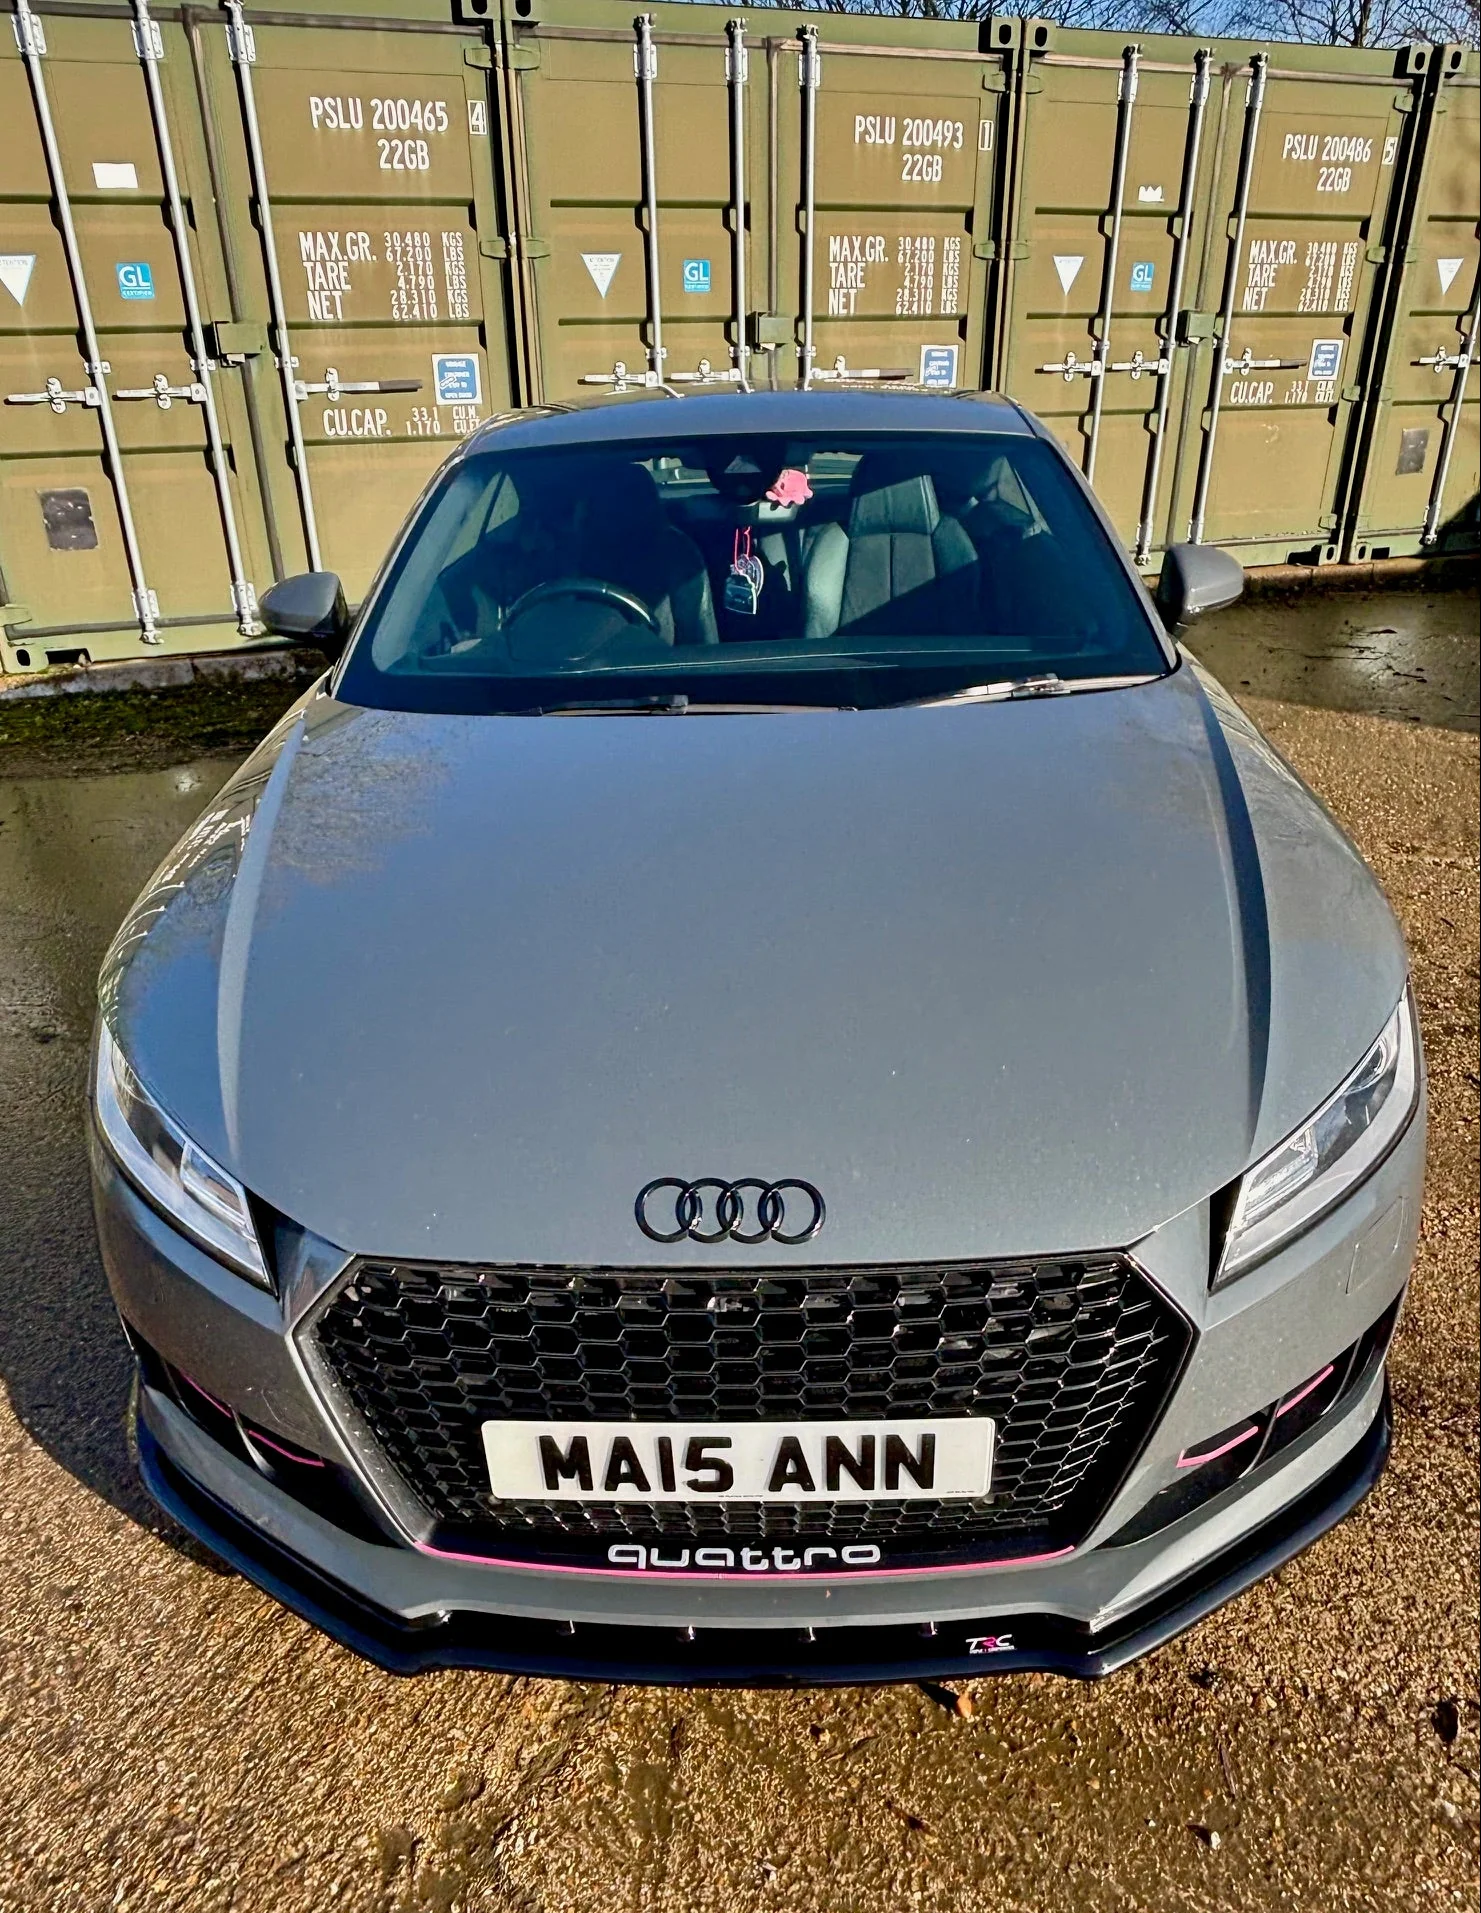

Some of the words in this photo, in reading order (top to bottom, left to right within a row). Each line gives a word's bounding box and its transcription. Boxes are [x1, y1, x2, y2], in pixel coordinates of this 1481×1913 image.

[309, 96, 364, 129] PSLU
[370, 98, 449, 132] 200465
[471, 102, 484, 131] 4
[854, 115, 896, 144] PSLU
[902, 117, 964, 149] 200493
[377, 138, 430, 170] 22GB
[1282, 133, 1319, 160] PSLU
[1321, 135, 1373, 163] 200486
[901, 153, 943, 182] 22GB
[1316, 166, 1352, 192] 22GB
[299, 231, 377, 261] MAX.GR.
[384, 231, 431, 247] 30.480
[441, 231, 463, 246] KGS
[385, 247, 432, 262] 67.200
[443, 247, 464, 261] LBS
[829, 236, 889, 263] MAX.GR.
[898, 236, 936, 250] 30.480
[943, 236, 961, 250] KGS
[897, 250, 935, 263] 67.200
[943, 250, 960, 263] LBS
[1249, 240, 1298, 264] MAX.GR.
[119, 265, 151, 287] GL
[303, 261, 352, 290] TARE
[396, 262, 433, 276] 2.170
[445, 261, 466, 275] KGS
[398, 276, 435, 290] 4.790
[446, 275, 467, 290] LBS
[685, 262, 709, 281] GL
[829, 262, 866, 288] TARE
[904, 263, 935, 276] 2.170
[942, 263, 960, 276] KGS
[903, 275, 934, 289] 4.790
[942, 275, 959, 289] LBS
[1132, 264, 1153, 282] GL
[1247, 263, 1278, 287] TARE
[307, 290, 343, 320] NET
[390, 290, 437, 305] 28.310
[447, 290, 469, 304] KGS
[392, 304, 438, 319] 62.410
[449, 304, 470, 319] LBS
[828, 288, 858, 316] NET
[896, 288, 933, 302] 28.310
[941, 288, 959, 301] KGS
[895, 301, 932, 315] 62.410
[940, 301, 957, 315] LBS
[1242, 286, 1269, 311] NET
[1229, 381, 1274, 404] CU.CAP.
[323, 408, 391, 437] CU.CAP.
[412, 406, 438, 422] 33.1
[405, 421, 441, 435] 1.170
[767, 1433, 937, 1492] ANN
[606, 1543, 882, 1573] quattro
